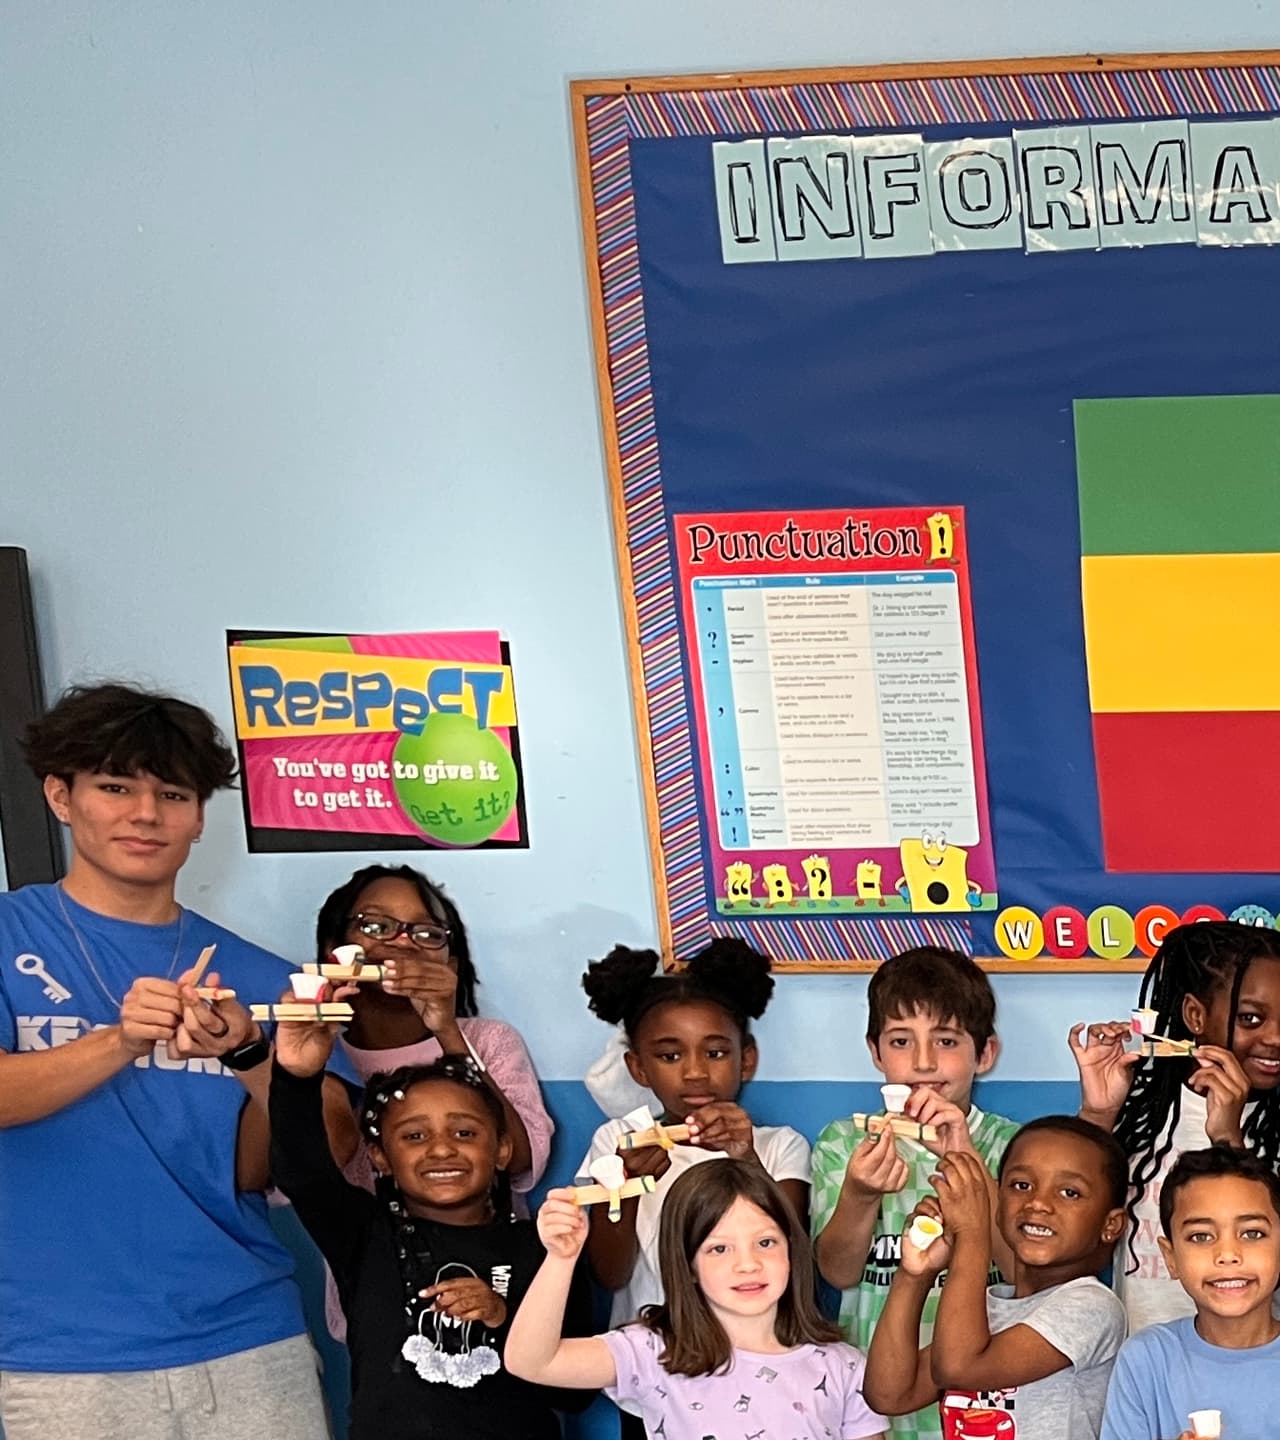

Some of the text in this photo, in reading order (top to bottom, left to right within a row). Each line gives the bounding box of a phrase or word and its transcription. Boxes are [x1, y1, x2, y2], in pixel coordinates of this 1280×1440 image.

[688, 517, 922, 563] Punctuation
[272, 757, 500, 784] You've got to give it
[293, 787, 393, 813] to get it.
